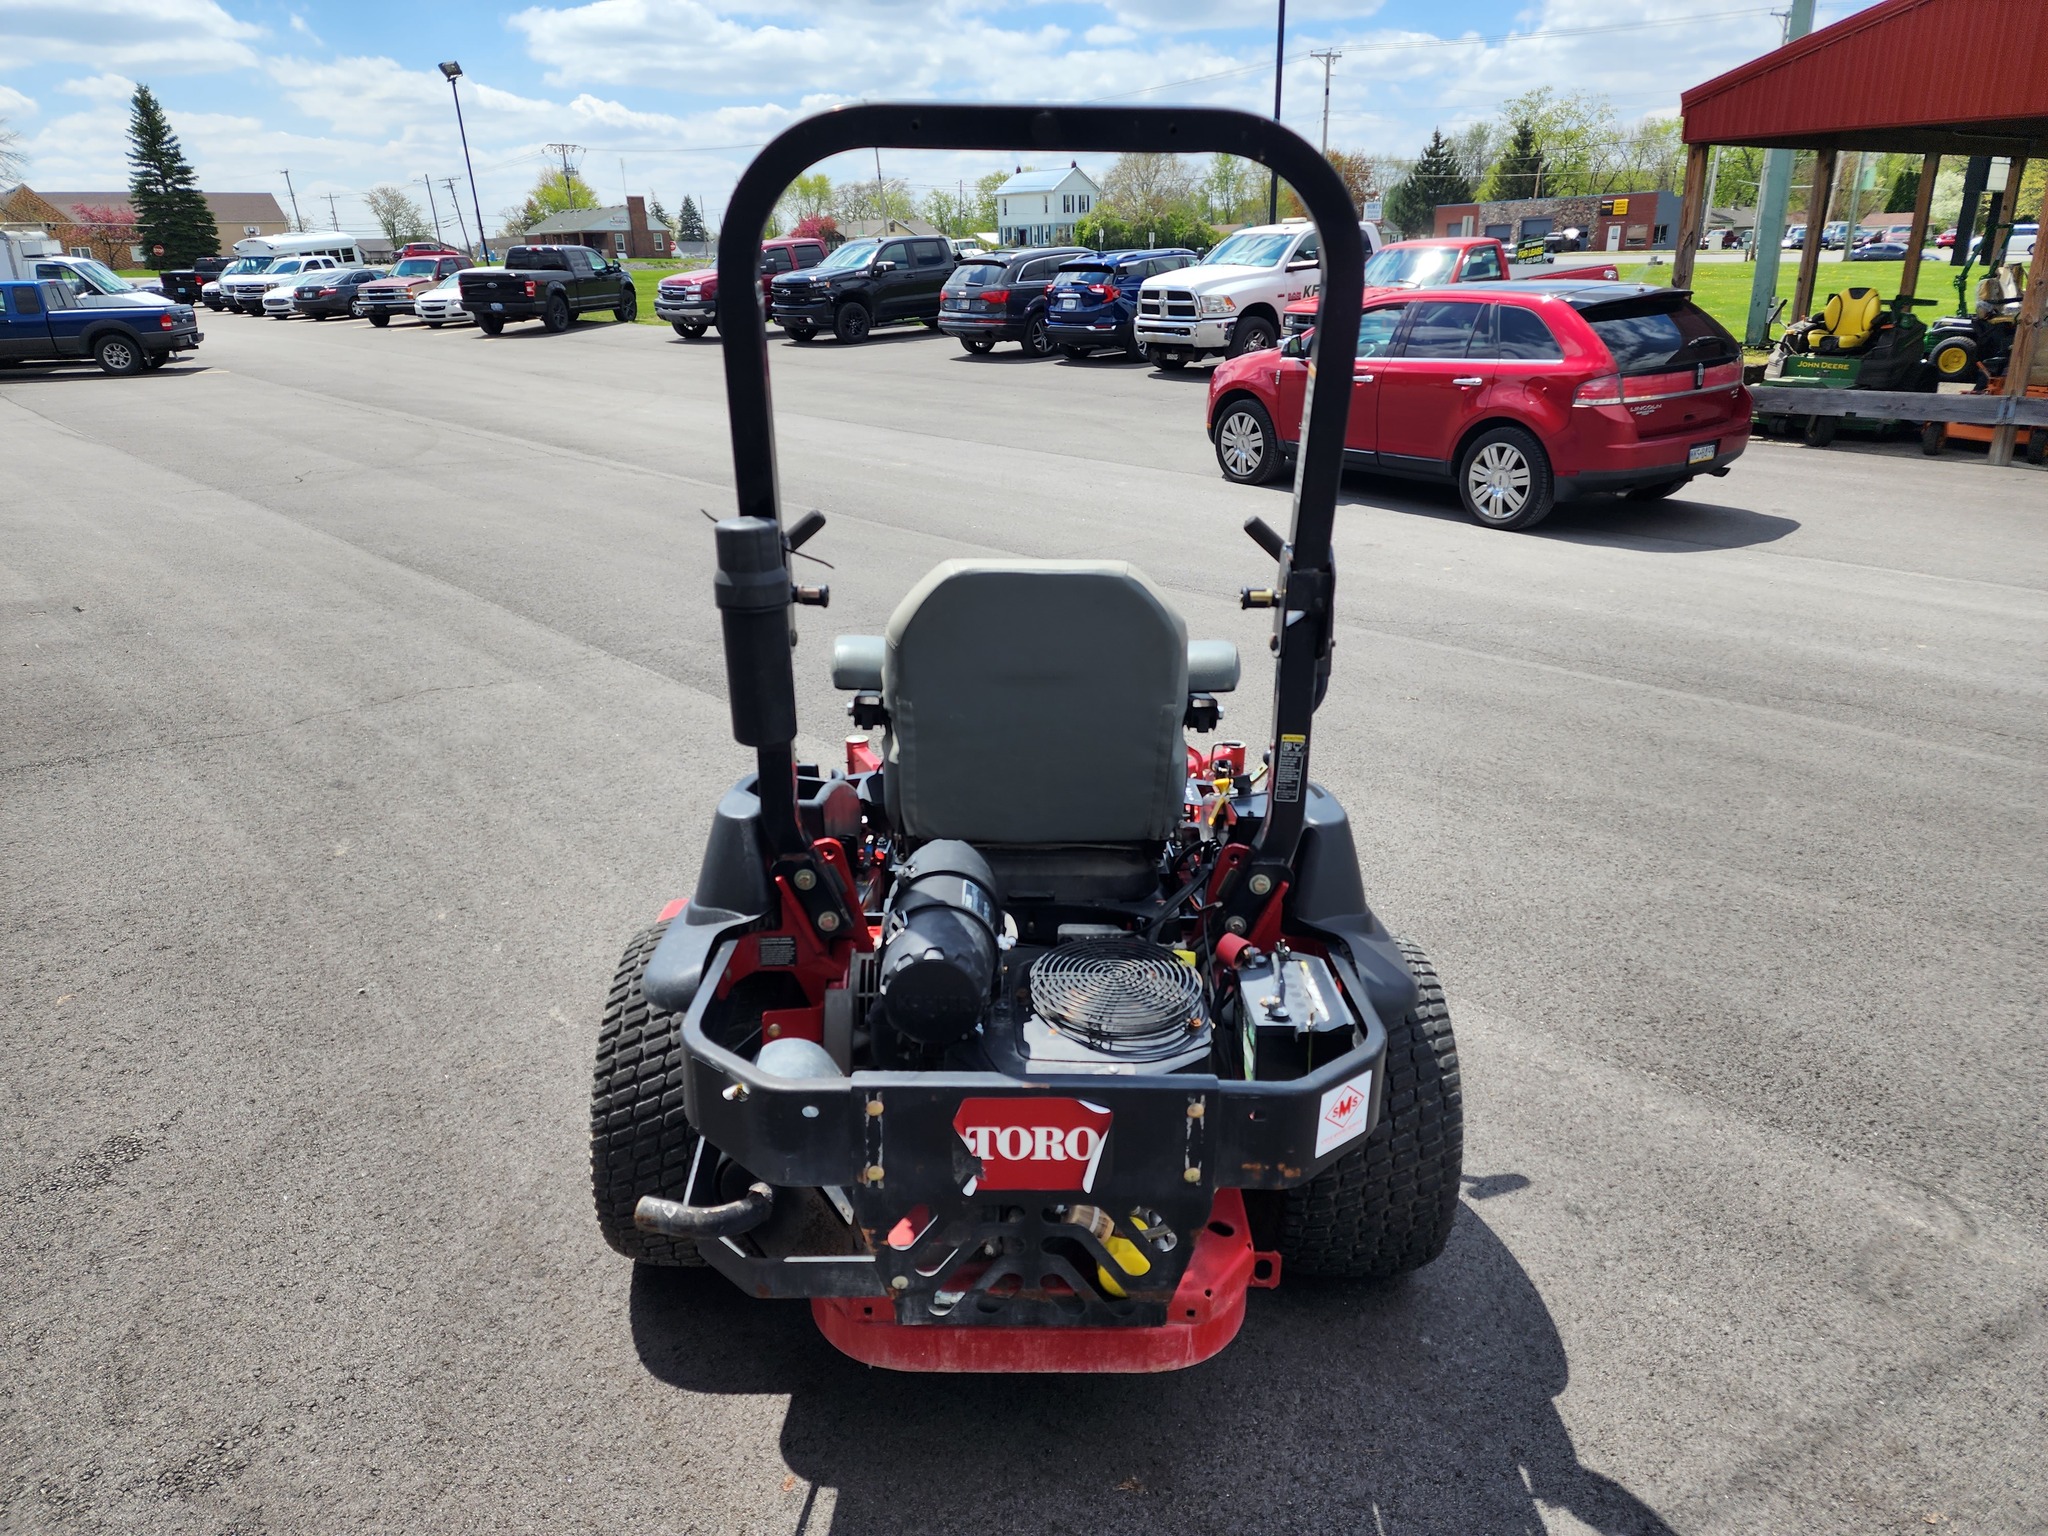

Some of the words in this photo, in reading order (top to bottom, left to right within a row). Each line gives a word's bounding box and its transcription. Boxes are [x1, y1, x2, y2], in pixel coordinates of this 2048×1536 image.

[1518, 250, 1528, 259] FOR
[1529, 246, 1544, 257] LEASE
[1821, 362, 1850, 370] DEERE
[1630, 403, 1662, 412] LINCOLN
[1332, 1096, 1358, 1119] SMS
[965, 1126, 1100, 1160] TORO
